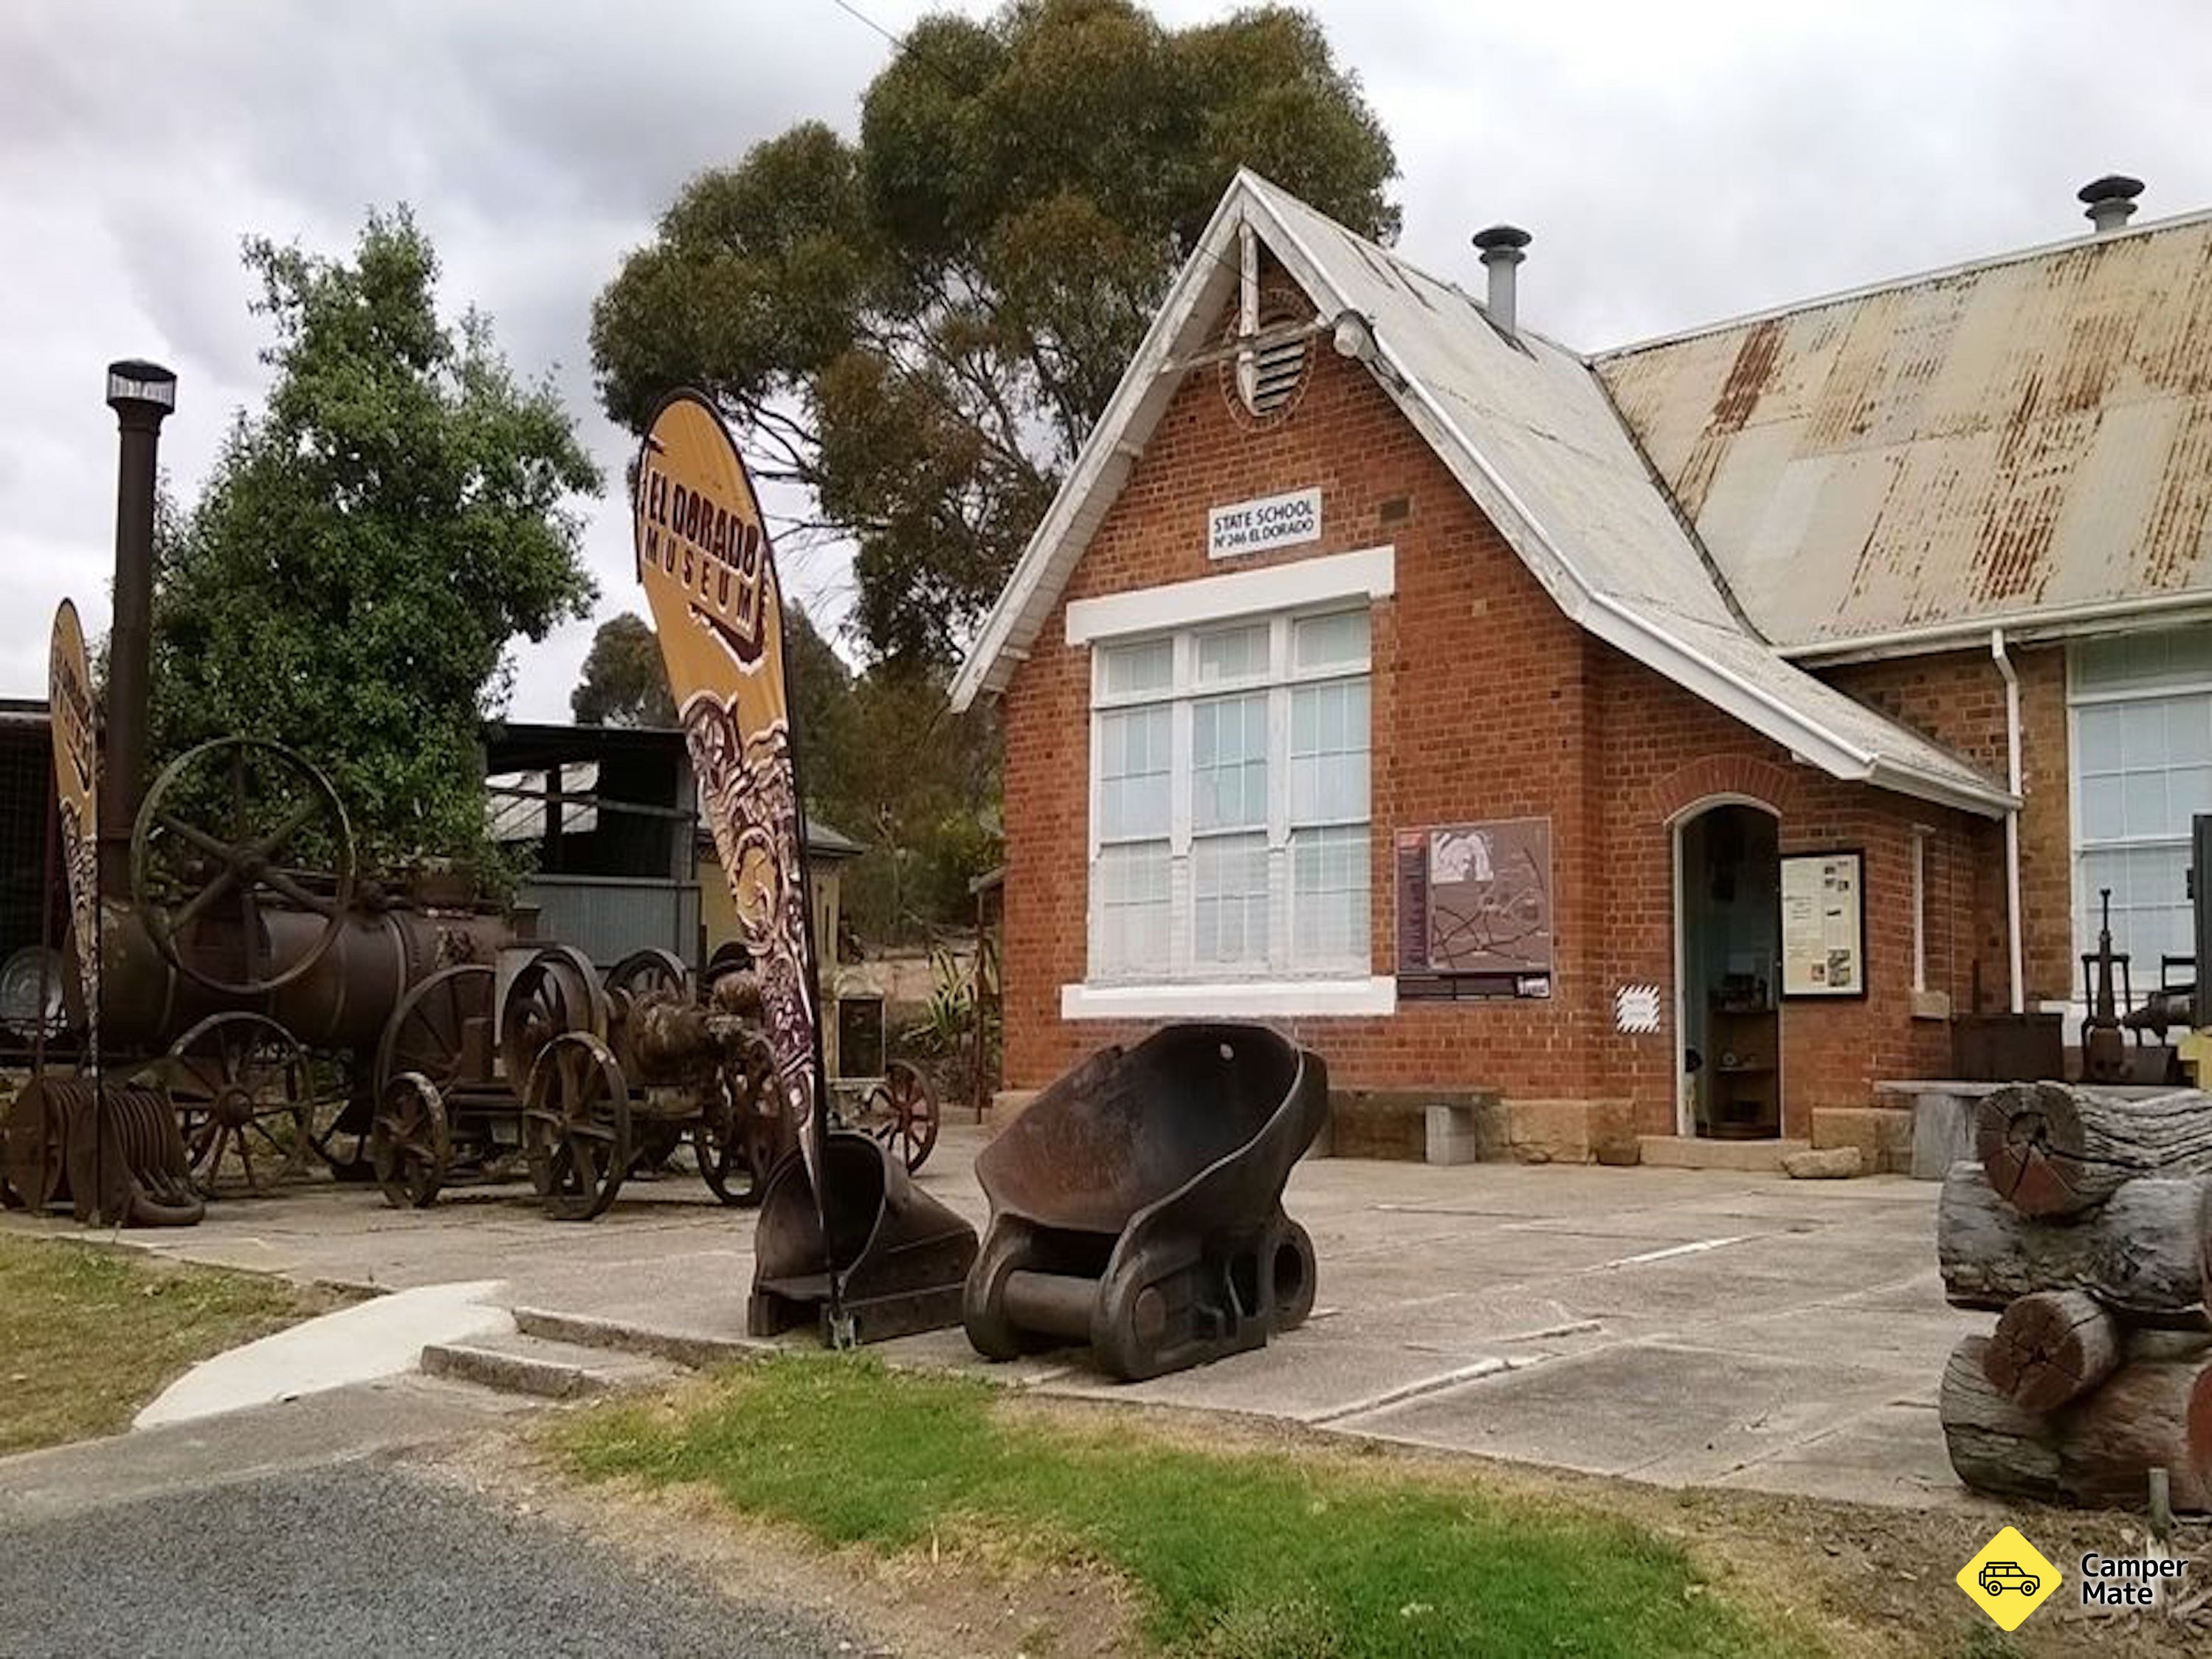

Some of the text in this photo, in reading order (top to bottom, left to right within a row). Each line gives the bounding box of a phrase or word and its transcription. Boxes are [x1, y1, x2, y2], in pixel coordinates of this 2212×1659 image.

[649, 471, 759, 581] EL DORADO
[1214, 500, 1314, 534] STATE SCHOOL
[644, 525, 751, 625] MUSEUM
